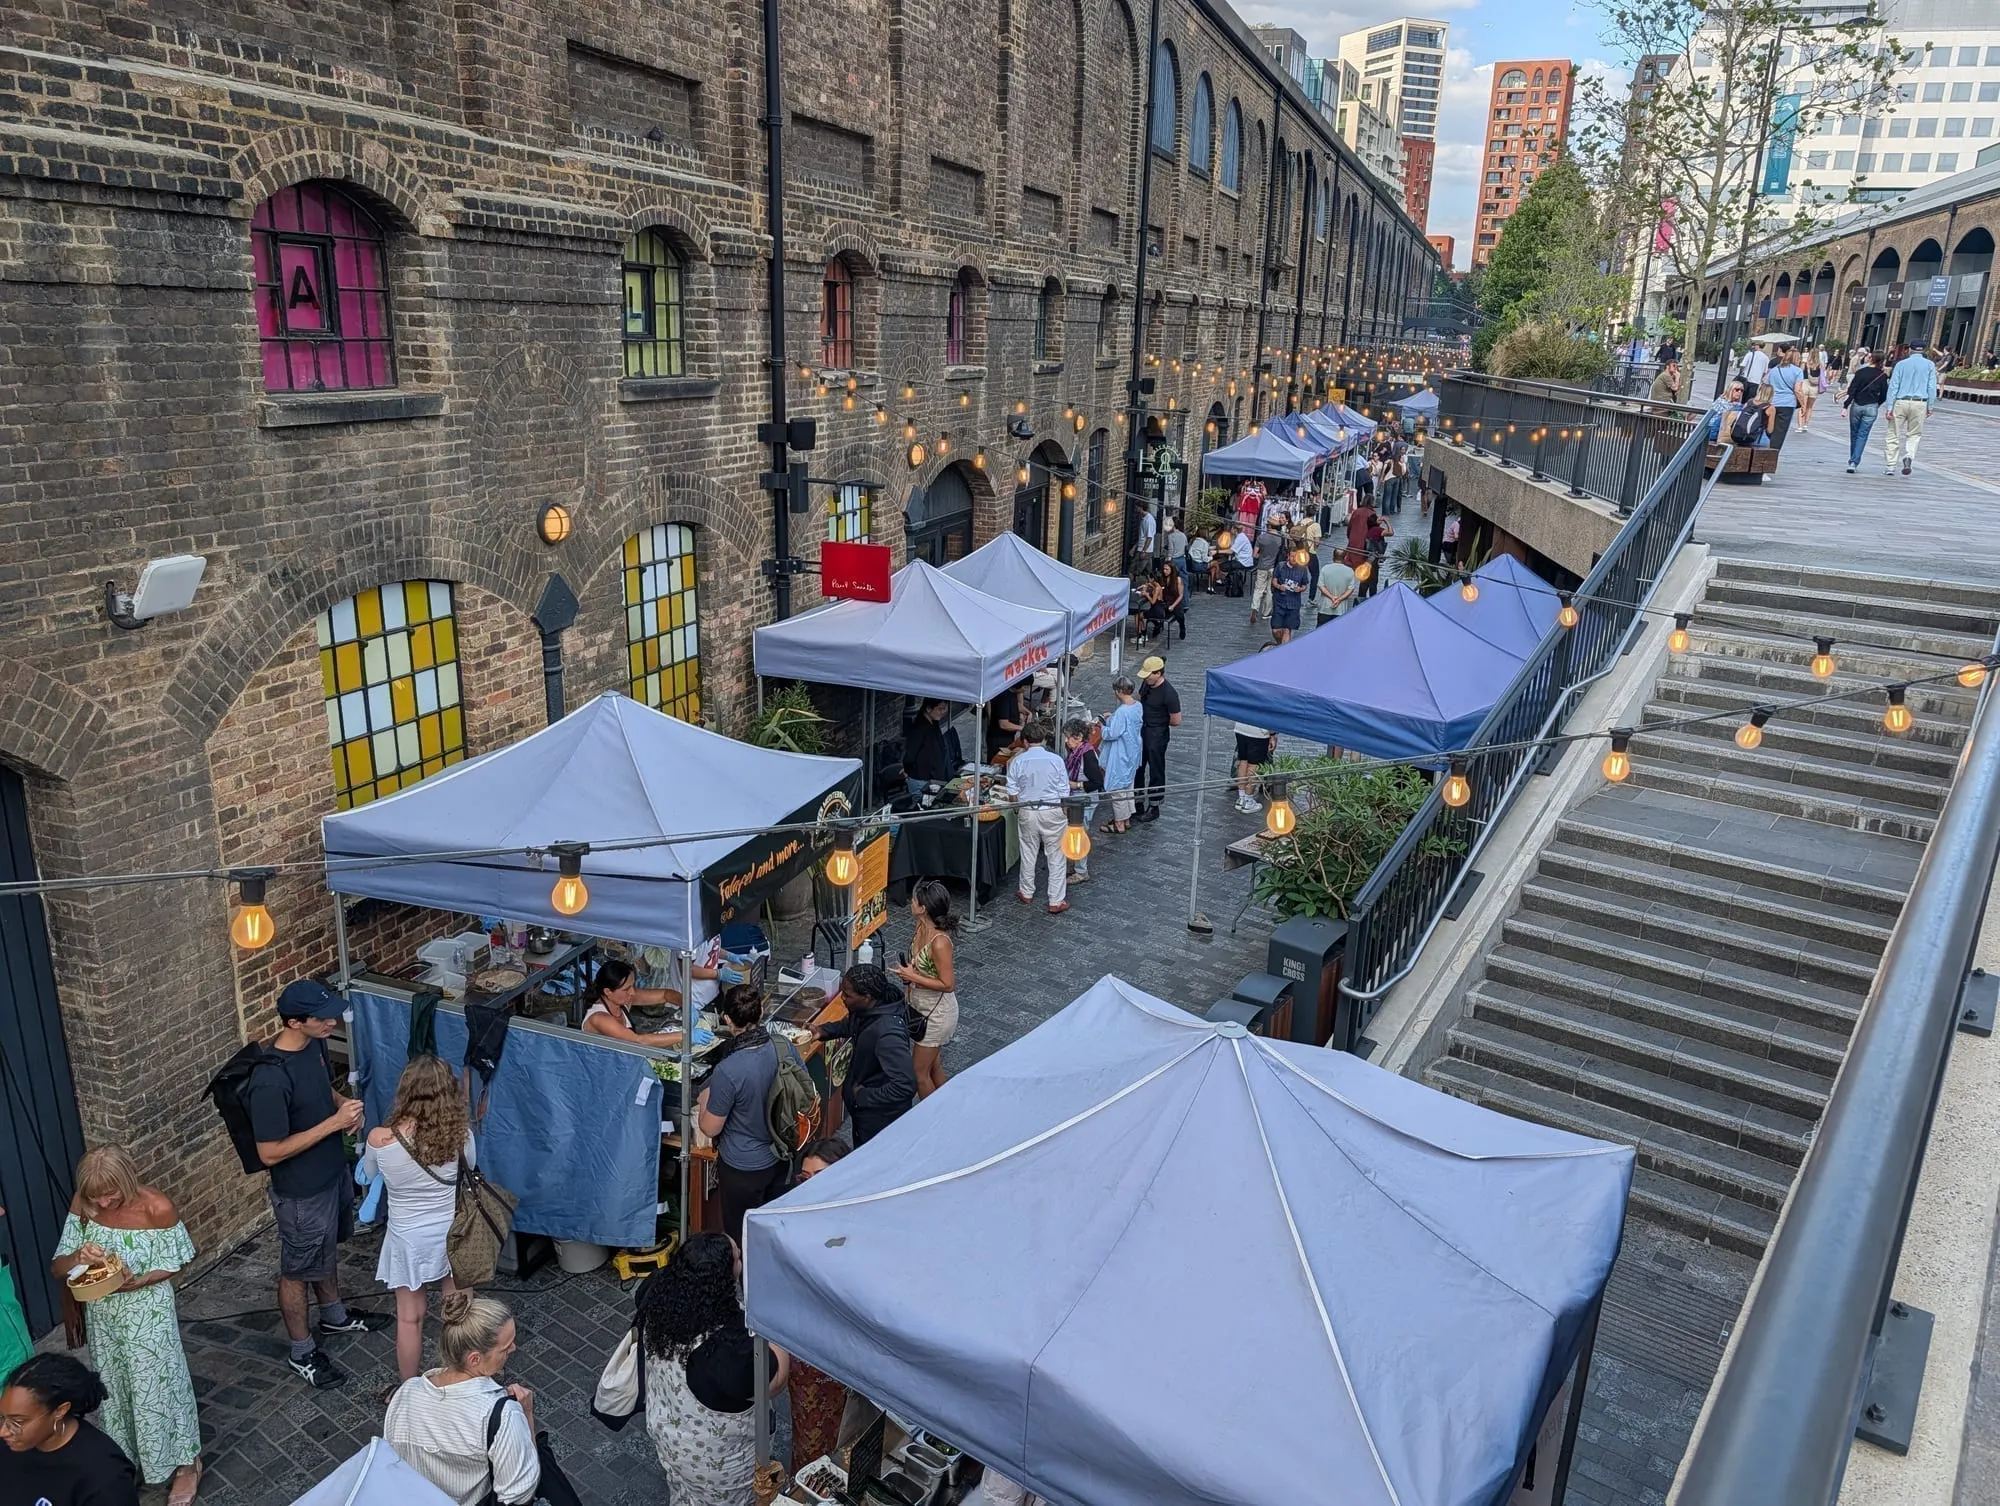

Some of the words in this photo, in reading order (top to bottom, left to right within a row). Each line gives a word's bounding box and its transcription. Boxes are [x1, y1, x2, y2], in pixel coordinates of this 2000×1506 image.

[289, 265, 321, 310] A
[831, 578, 849, 589] Paul
[852, 580, 876, 592] Smith
[1003, 642, 1048, 681] market
[718, 862, 756, 907] Falafel
[756, 850, 776, 880] and
[776, 839, 805, 866] more...
[1282, 966, 1305, 982] CROSS
